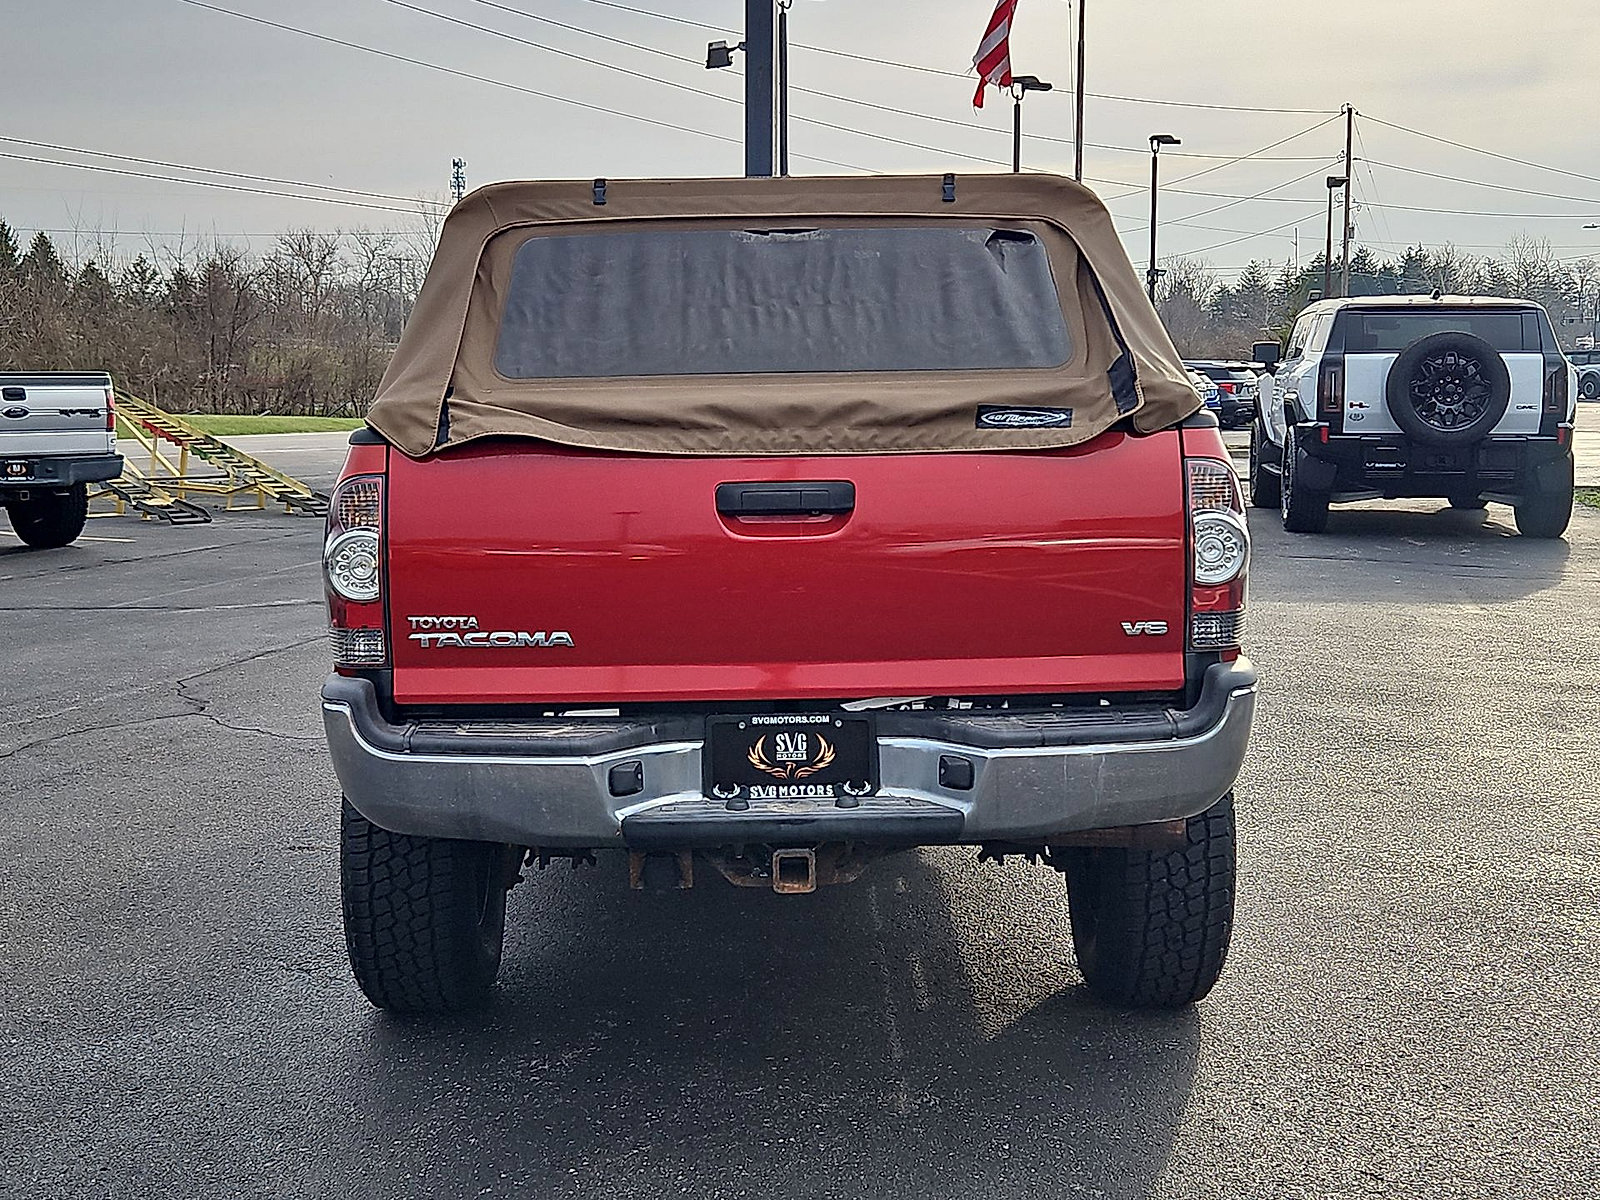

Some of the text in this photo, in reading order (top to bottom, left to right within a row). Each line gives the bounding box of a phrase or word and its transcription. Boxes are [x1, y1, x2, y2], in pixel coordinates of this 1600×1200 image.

[407, 616, 479, 629] TOYOTA
[1121, 621, 1168, 635] V6
[408, 632, 575, 648] TACOMA
[751, 715, 830, 725] SVGMOTORS.COM
[775, 732, 807, 754] SVG
[750, 785, 834, 798] SVG MOTORS
